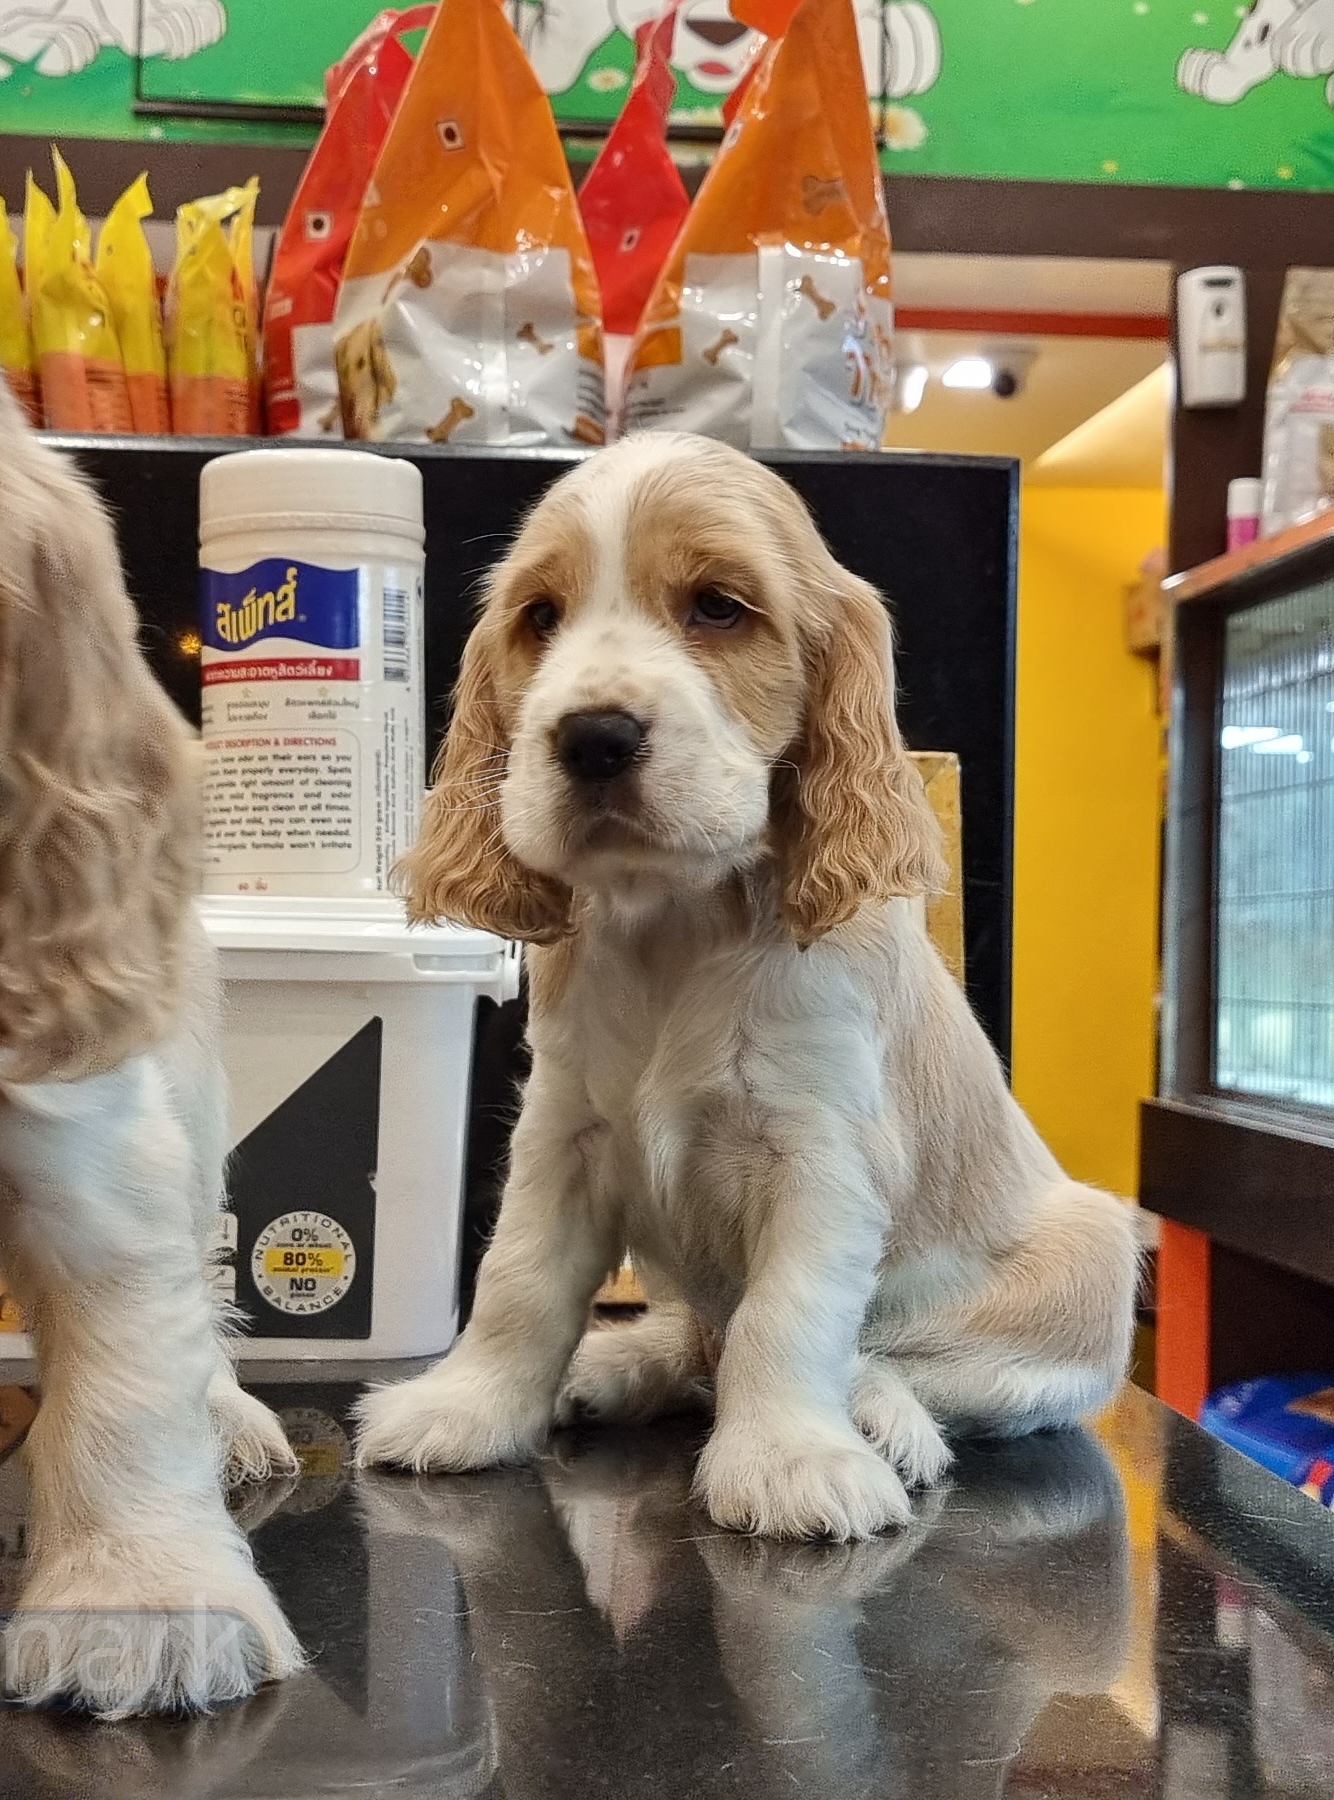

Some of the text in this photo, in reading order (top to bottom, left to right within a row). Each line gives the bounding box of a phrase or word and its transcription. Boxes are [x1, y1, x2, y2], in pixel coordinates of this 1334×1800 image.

[284, 737, 337, 746] DIRECTIONS
[336, 754, 352, 763] you
[299, 778, 309, 786] of
[315, 778, 352, 788] cleaning
[261, 829, 281, 838] body
[255, 1213, 352, 1262] NUTRITIONAL
[291, 1228, 319, 1241] 0%
[283, 1252, 323, 1266] 80%
[290, 1277, 317, 1291] NO
[263, 1285, 343, 1312] BALANCE
